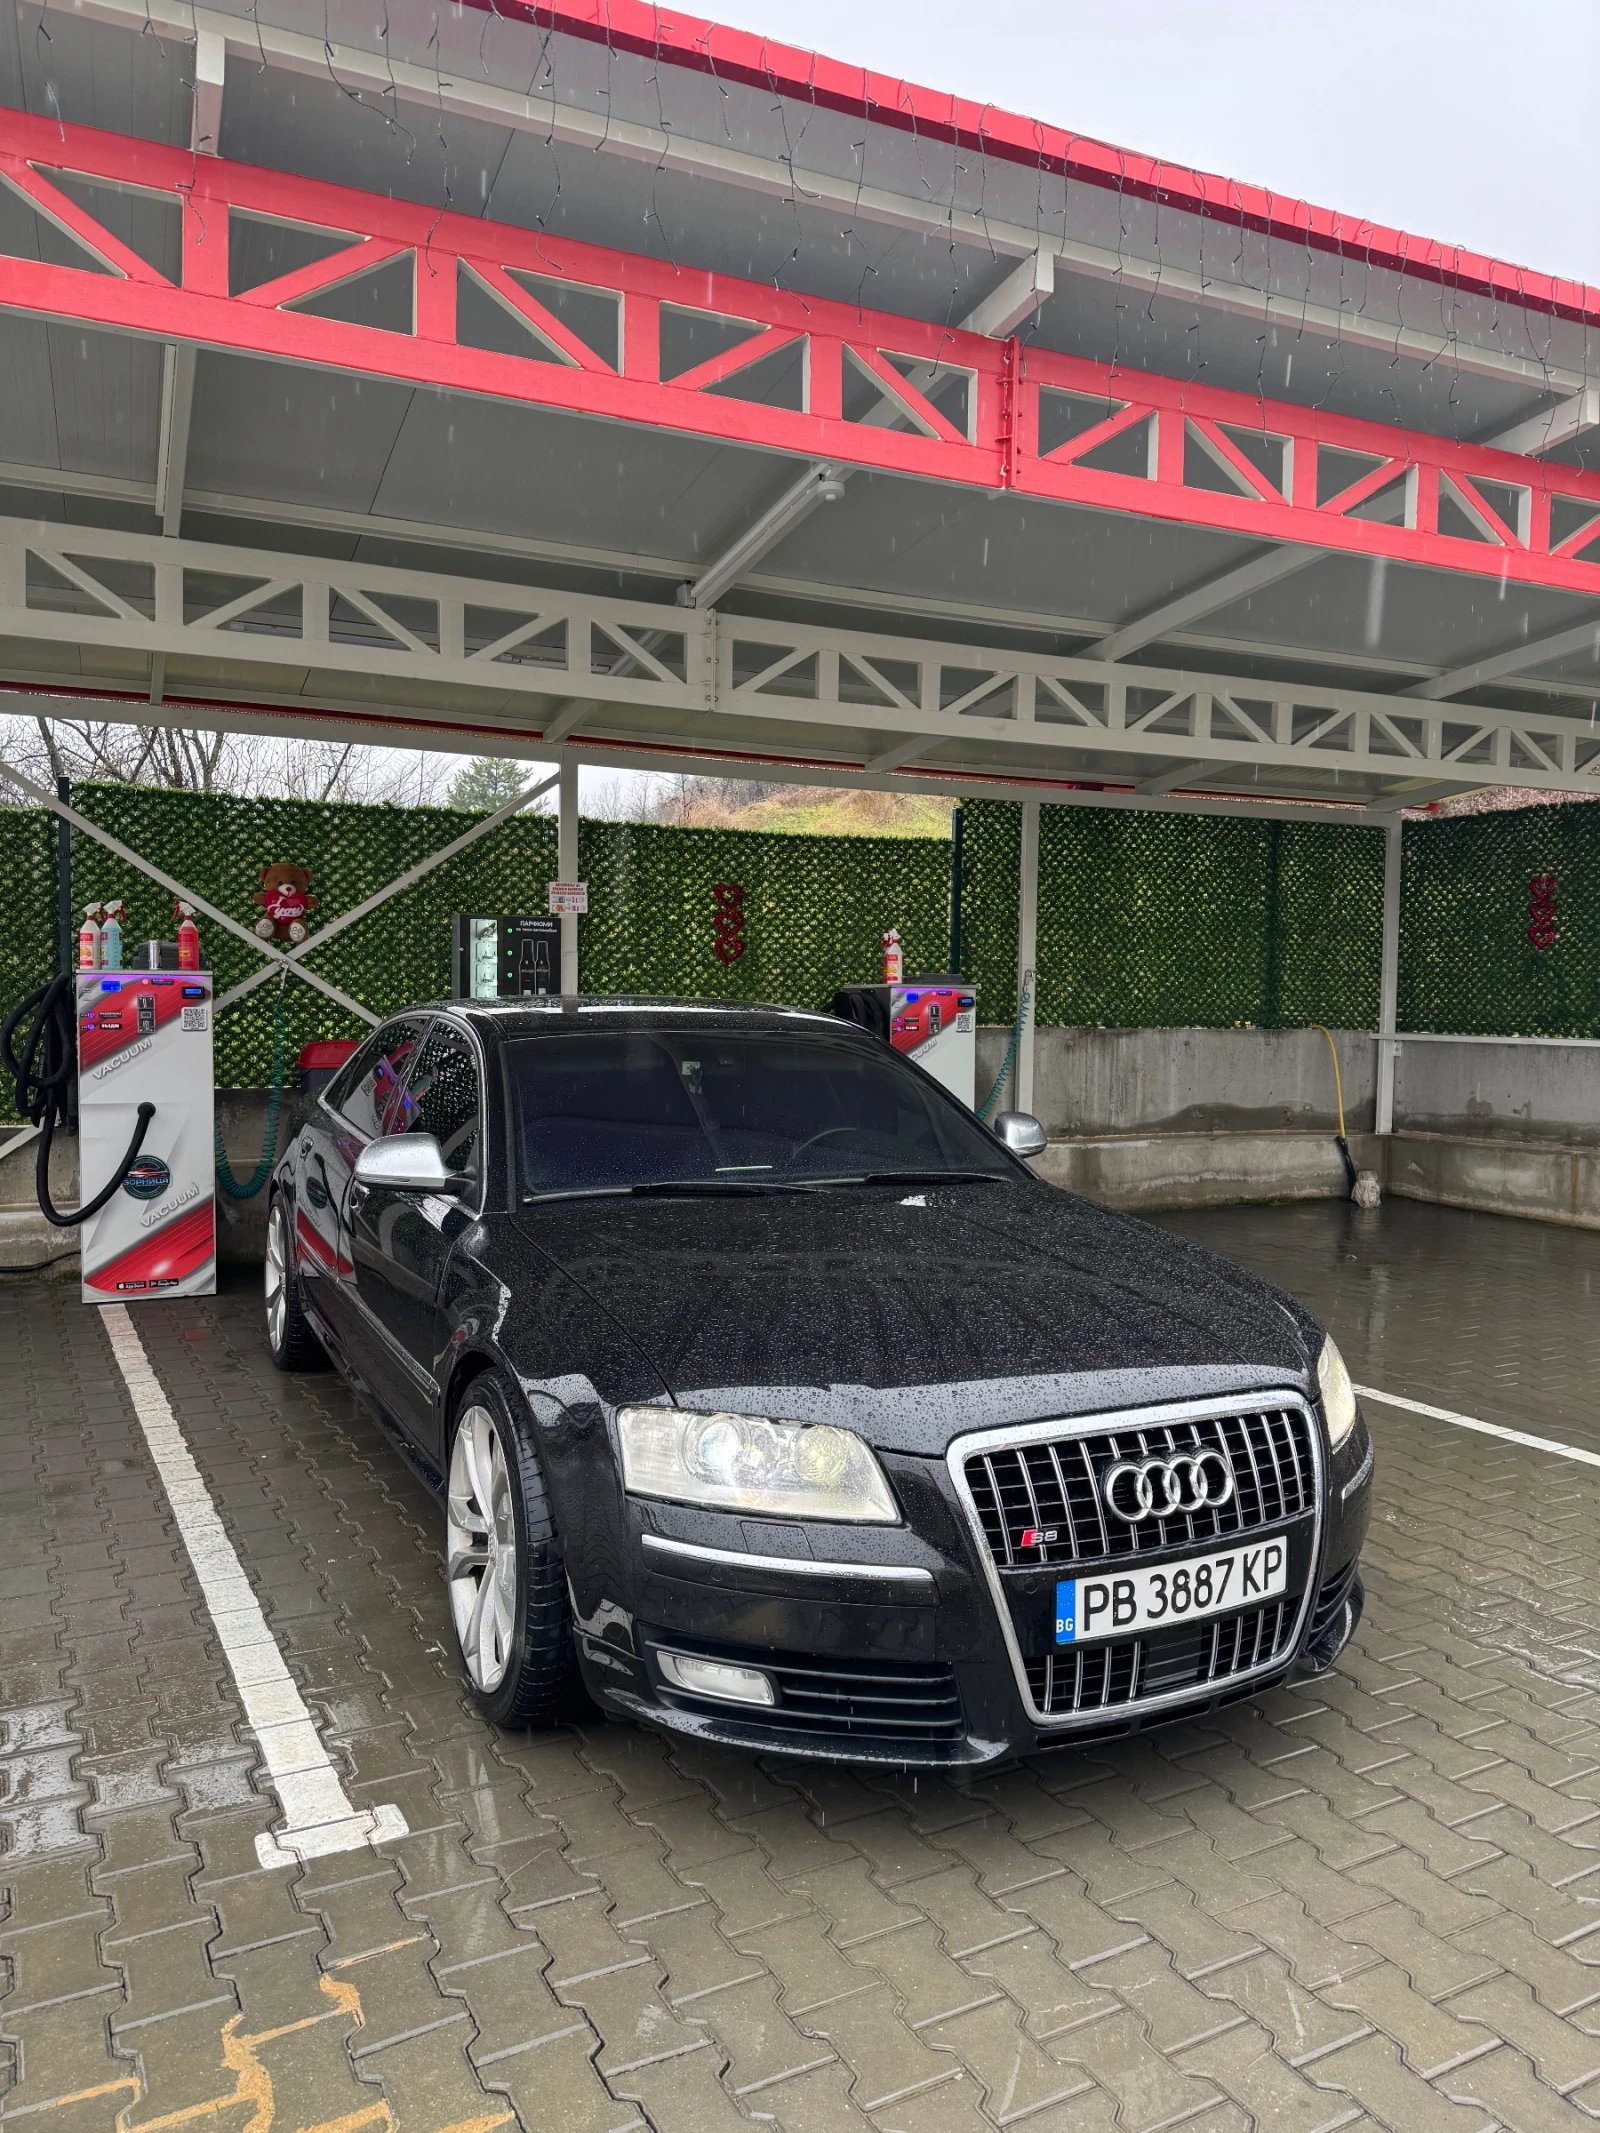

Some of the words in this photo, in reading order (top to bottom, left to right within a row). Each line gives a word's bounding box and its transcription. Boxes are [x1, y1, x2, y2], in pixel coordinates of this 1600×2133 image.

[520, 920, 553, 928] ПАРФЮМИ
[93, 1038, 152, 1080] VACUUM
[911, 1037, 938, 1061] CUUM
[123, 1178, 169, 1186] ЗОРНИЦА
[141, 1186, 199, 1227] VACUUM
[1030, 1530, 1058, 1544] S8
[1083, 1579, 1138, 1632] PB
[1147, 1556, 1235, 1619] 3887
[1242, 1544, 1282, 1598] KP
[1056, 1618, 1074, 1634] BG
